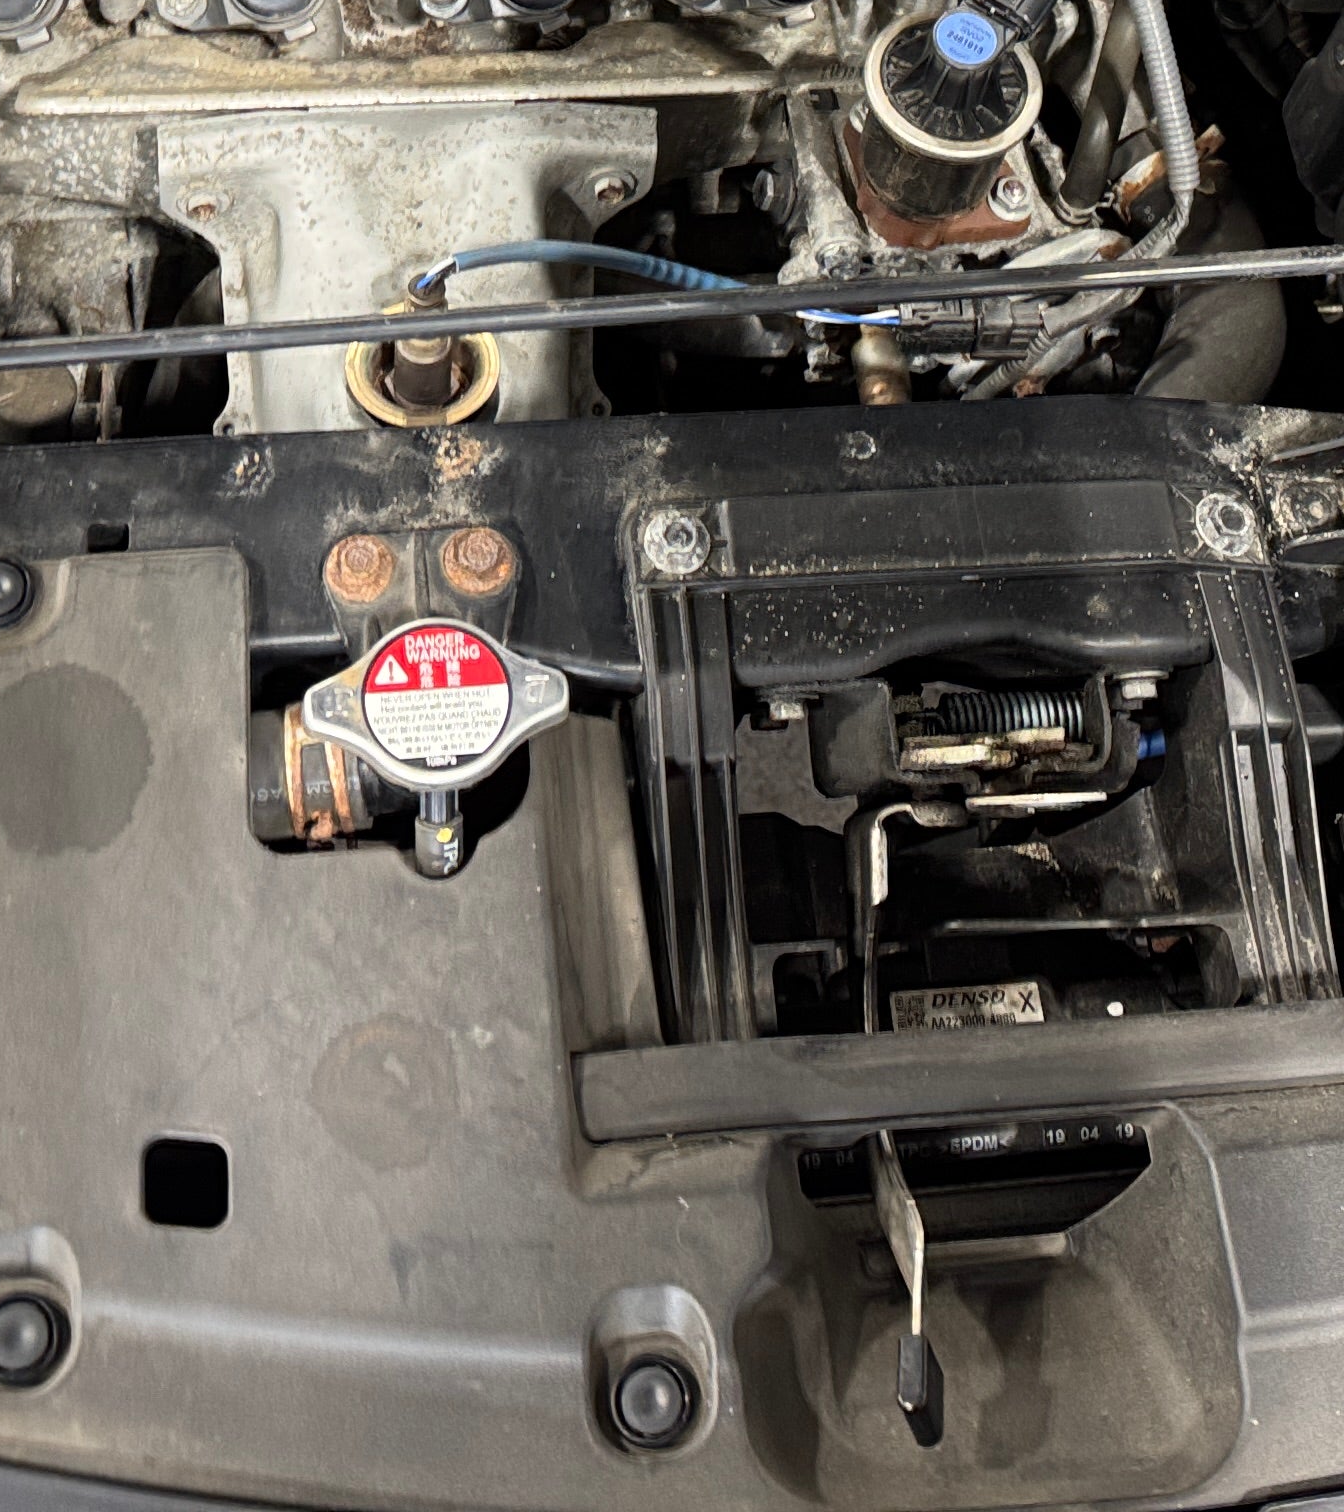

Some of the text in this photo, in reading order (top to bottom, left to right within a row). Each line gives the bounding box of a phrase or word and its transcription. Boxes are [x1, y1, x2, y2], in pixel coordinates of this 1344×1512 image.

[404, 631, 465, 651] DANGER
[406, 643, 481, 665] WARNUNG
[931, 989, 1036, 1014] DENSO X
[1045, 1128, 1066, 1145] 19
[1080, 1125, 1100, 1141] 04
[1115, 1122, 1135, 1139] 19
